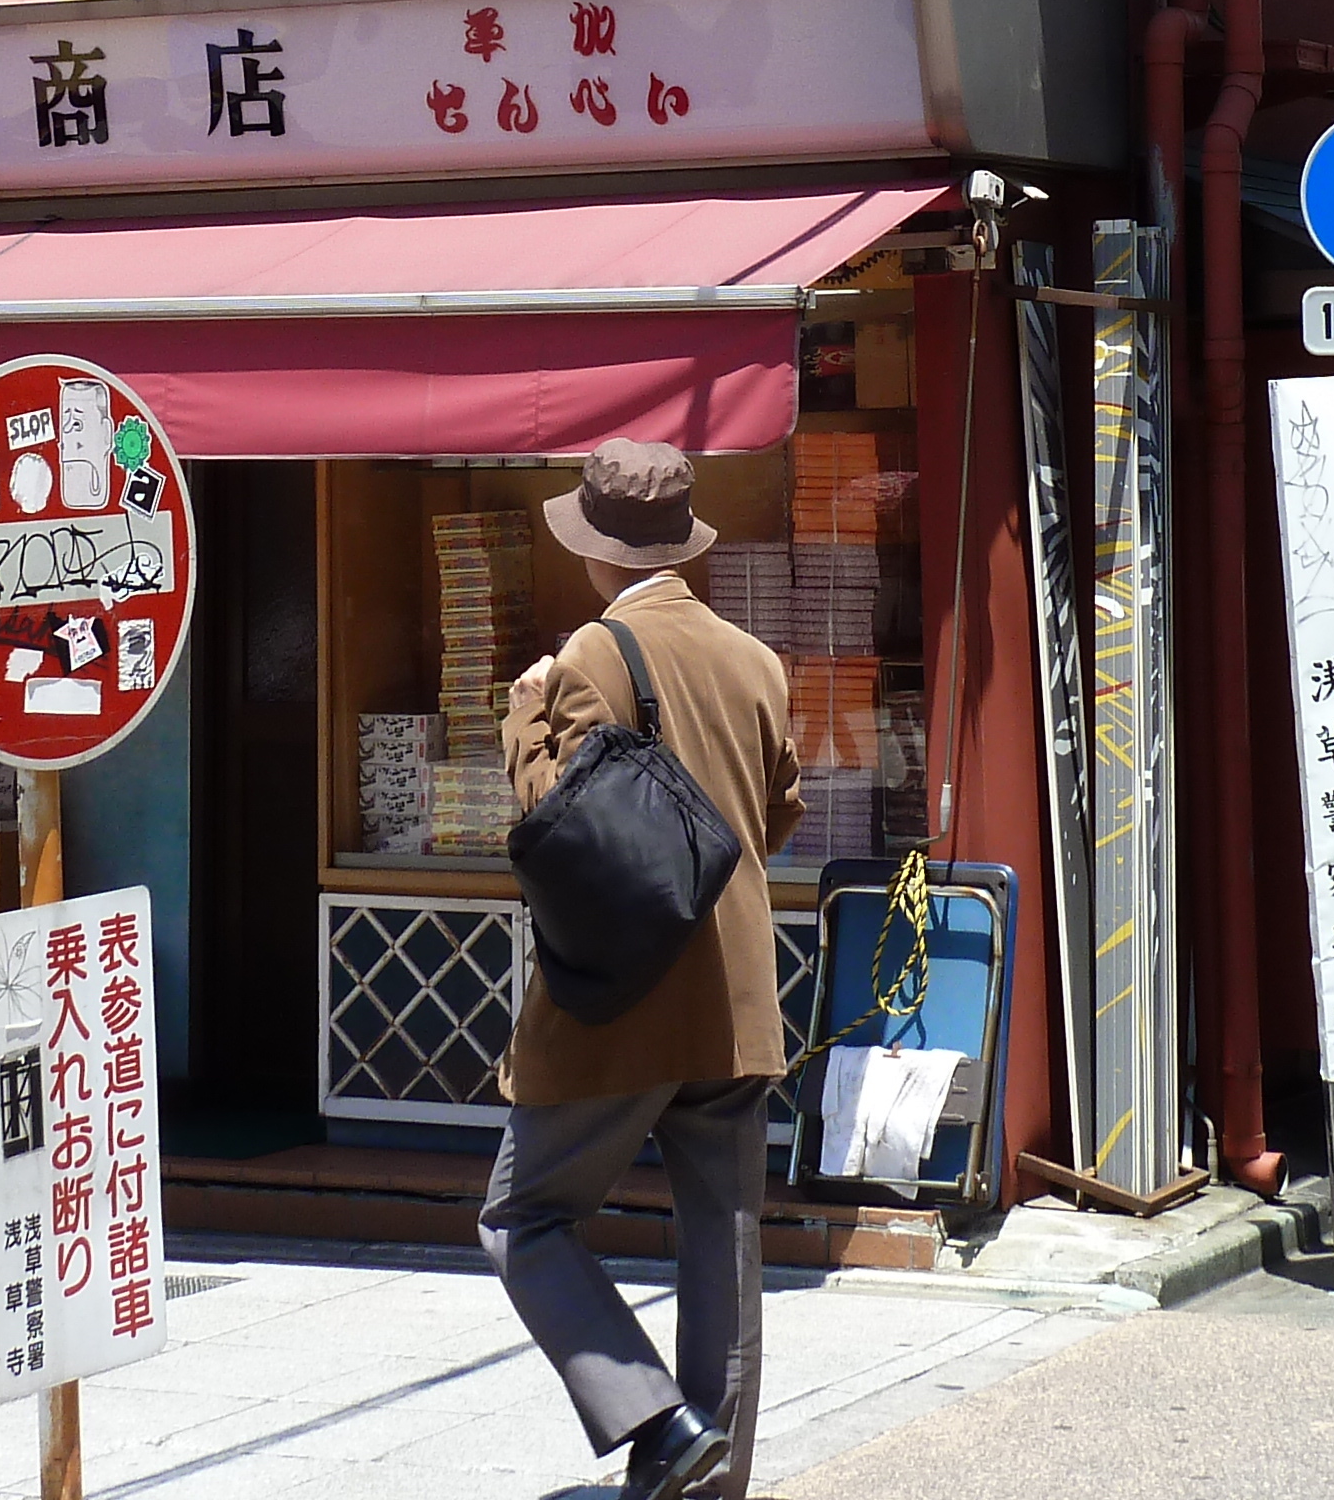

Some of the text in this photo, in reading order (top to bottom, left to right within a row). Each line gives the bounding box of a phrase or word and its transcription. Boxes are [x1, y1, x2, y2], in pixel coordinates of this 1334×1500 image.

[426, 72, 690, 134] せんべい
[9, 411, 53, 443] SLOP
[46, 922, 94, 1299] 乗入れお断り
[98, 911, 154, 1339] 表参道に付諸車
[4, 1218, 26, 1377] 浅草寺
[23, 1212, 46, 1372] 浅草警察署
